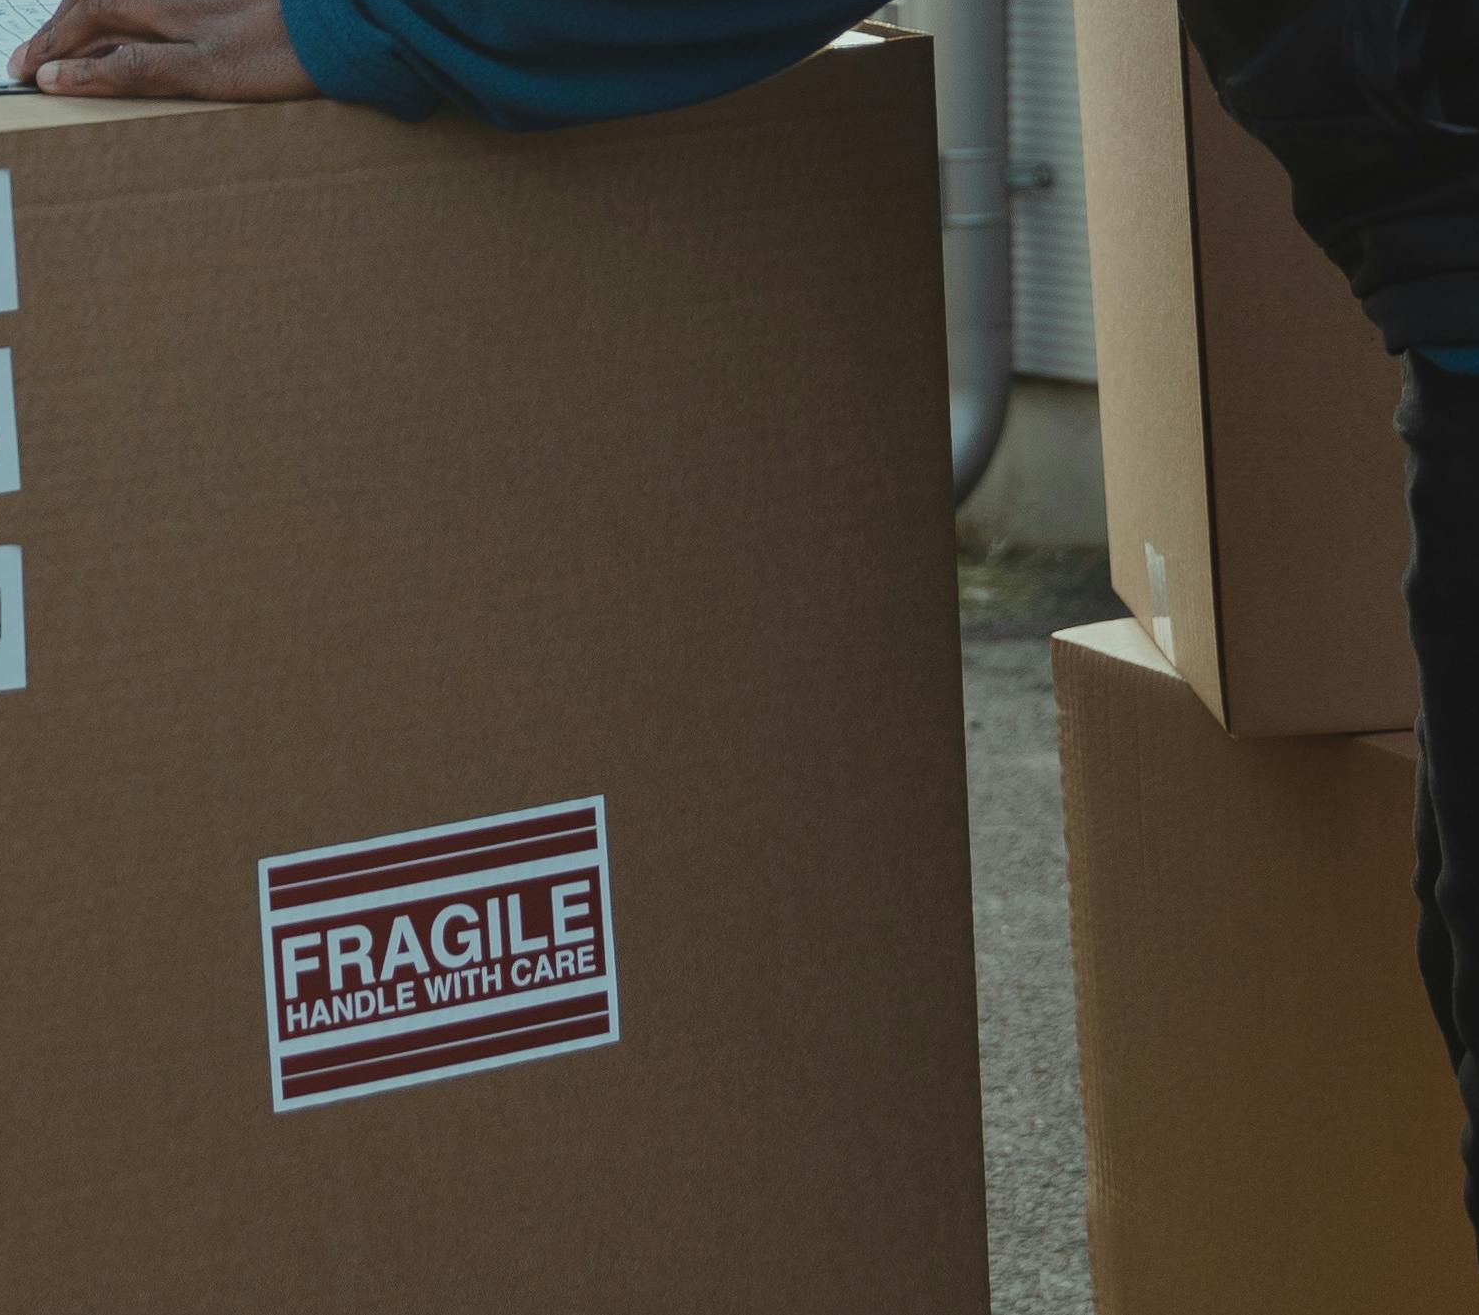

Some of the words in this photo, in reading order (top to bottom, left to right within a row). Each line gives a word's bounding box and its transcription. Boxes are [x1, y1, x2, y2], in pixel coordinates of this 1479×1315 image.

[280, 879, 596, 1000] FRAGILE
[285, 980, 417, 1032] HANDLE
[423, 962, 503, 1004] WITH
[509, 945, 597, 987] CARE
